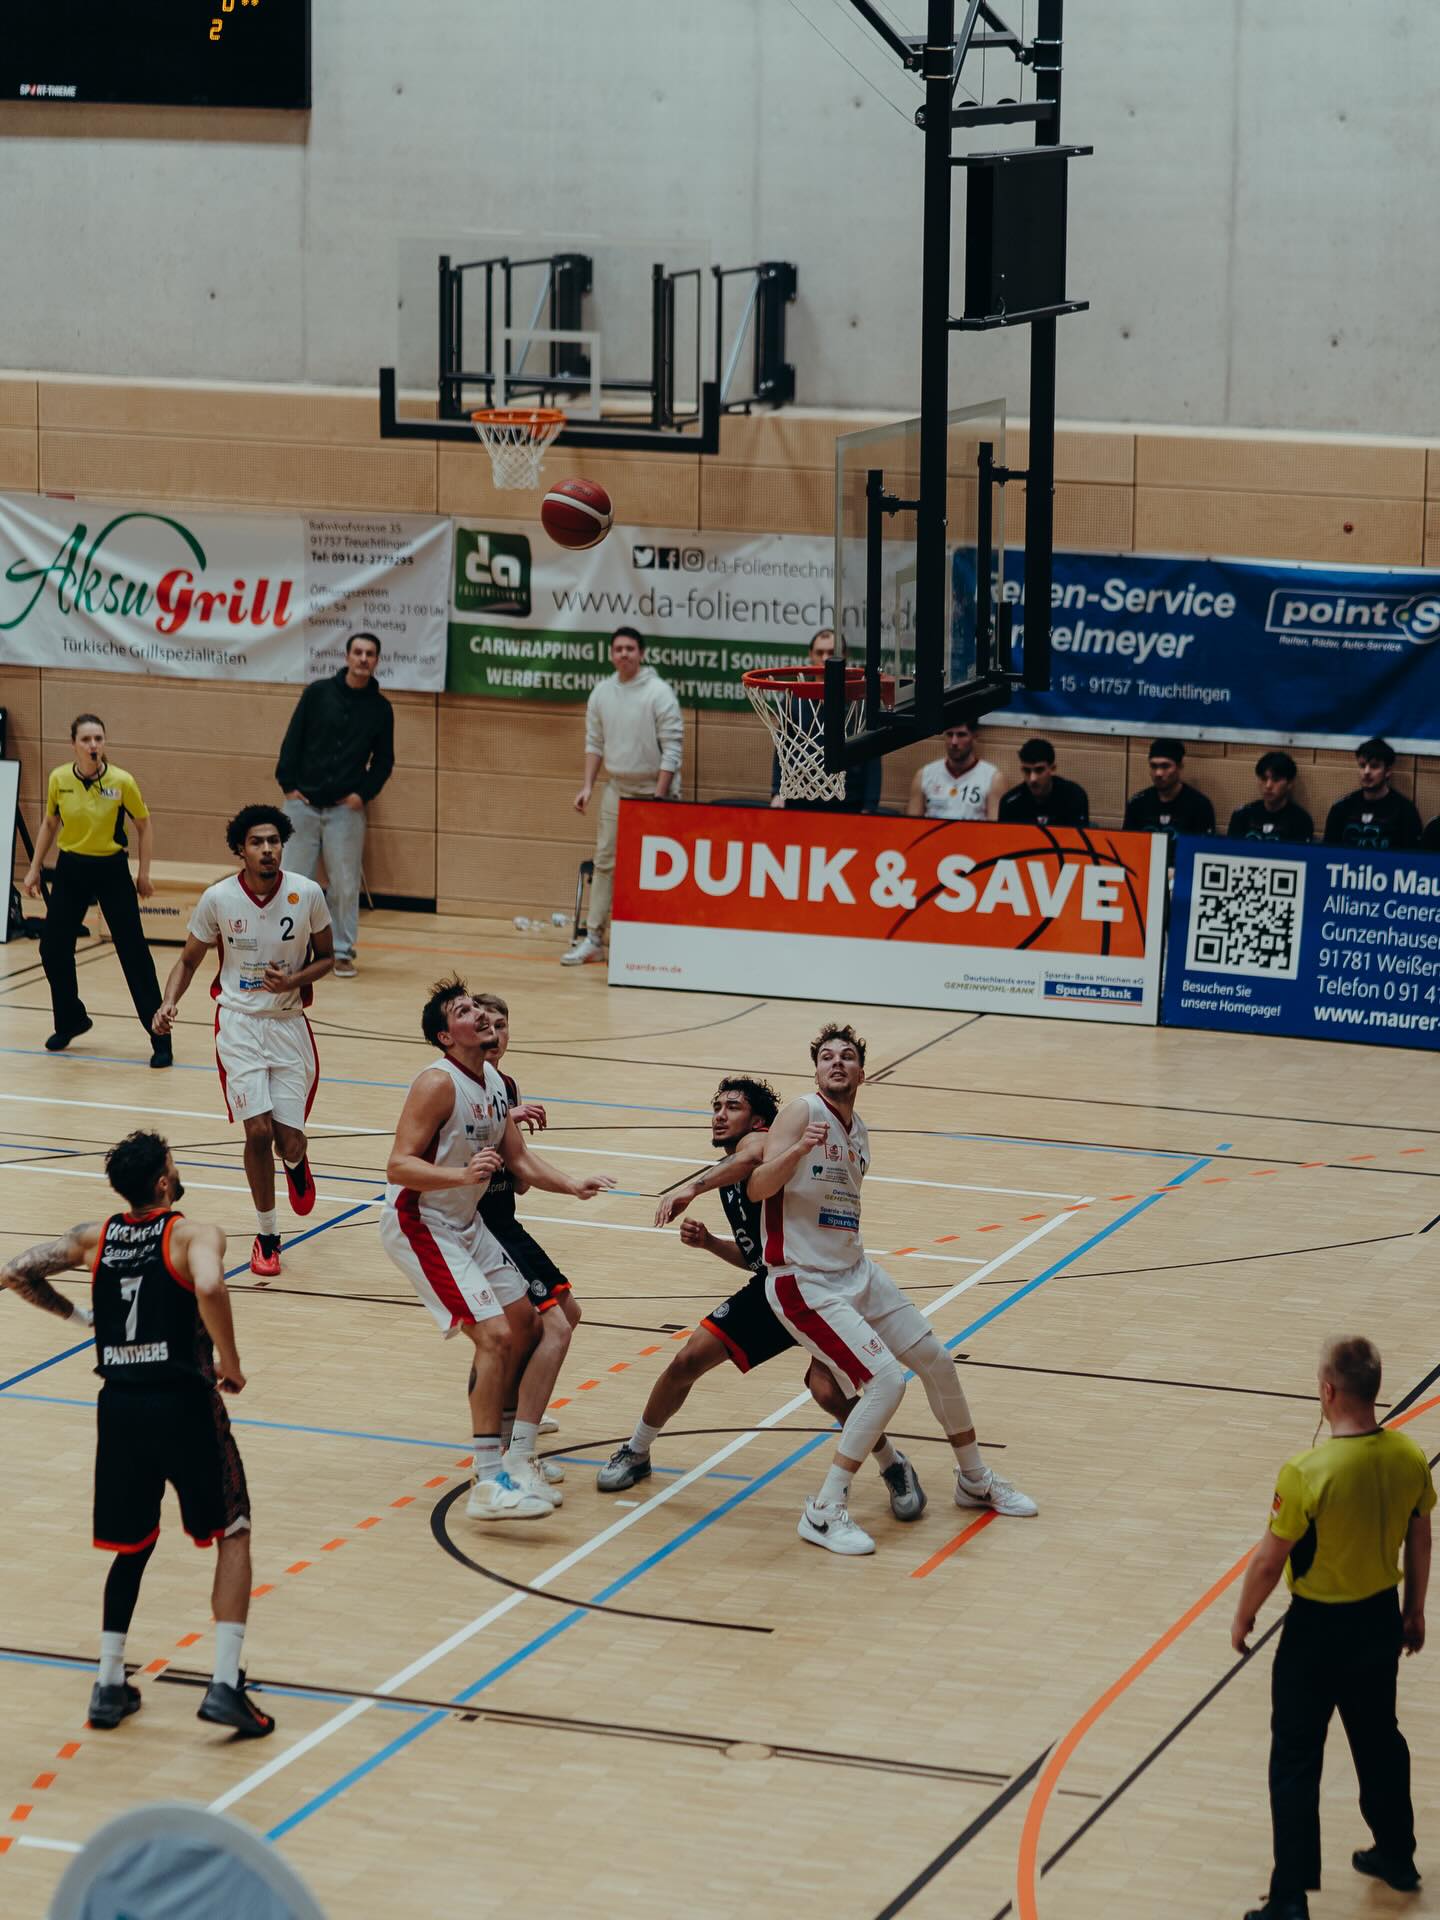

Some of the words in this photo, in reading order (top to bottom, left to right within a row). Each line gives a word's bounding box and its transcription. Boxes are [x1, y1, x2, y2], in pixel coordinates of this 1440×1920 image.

[210, 18, 223, 40] 2
[465, 534, 521, 588] da
[156, 569, 293, 635] Grill
[1282, 598, 1389, 626] point
[1411, 600, 1440, 634] S
[62, 636, 127, 657] Türkische
[129, 643, 247, 666] Grillspezialitäten
[470, 636, 594, 660] CARWRAPPING
[1061, 676, 1076, 691] 15
[1089, 677, 1132, 695] 91757
[1136, 680, 1231, 704] Treuchtlingen
[962, 785, 980, 804] 15
[638, 834, 858, 905] DUNK
[869, 850, 918, 910] &
[934, 853, 1128, 923] SAVE
[1326, 862, 1388, 892] Thilo
[1323, 895, 1380, 918] Allianz
[280, 916, 295, 941] 2
[1321, 921, 1440, 950] Gunzenhause
[1319, 948, 1371, 970] 91781
[1055, 983, 1132, 999] Sparda-Bank
[1182, 979, 1233, 996] Besuchen
[1235, 983, 1252, 998] Sie
[1317, 975, 1379, 999] Telefon
[1383, 981, 1395, 1000] 0
[1399, 982, 1418, 1002] 91
[1181, 998, 1218, 1010] unsere
[1219, 1000, 1282, 1019] Homepage!
[119, 1275, 144, 1342] 7
[103, 1341, 169, 1365] PANTHERS
